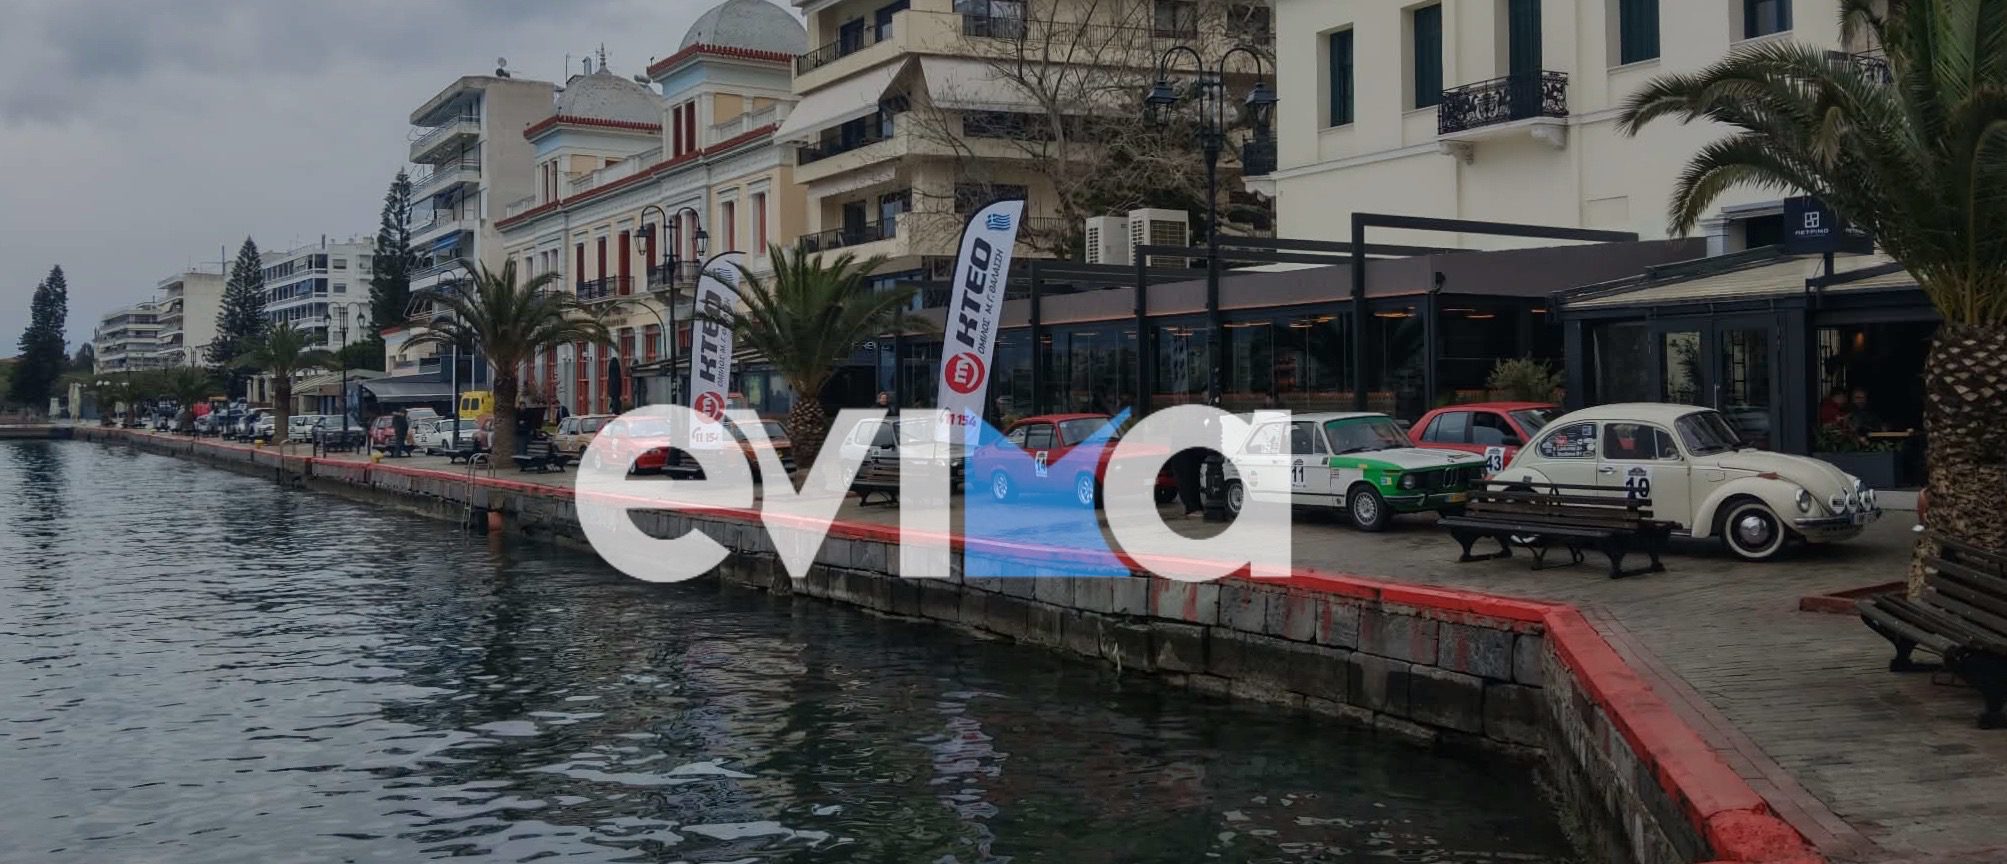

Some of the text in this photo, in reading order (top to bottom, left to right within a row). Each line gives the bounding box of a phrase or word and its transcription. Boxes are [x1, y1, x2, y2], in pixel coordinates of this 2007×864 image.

[956, 237, 992, 348] ΚΤΕΟ
[954, 353, 979, 389] my
[1292, 466, 1304, 483] 11
[1485, 455, 1501, 471] 43
